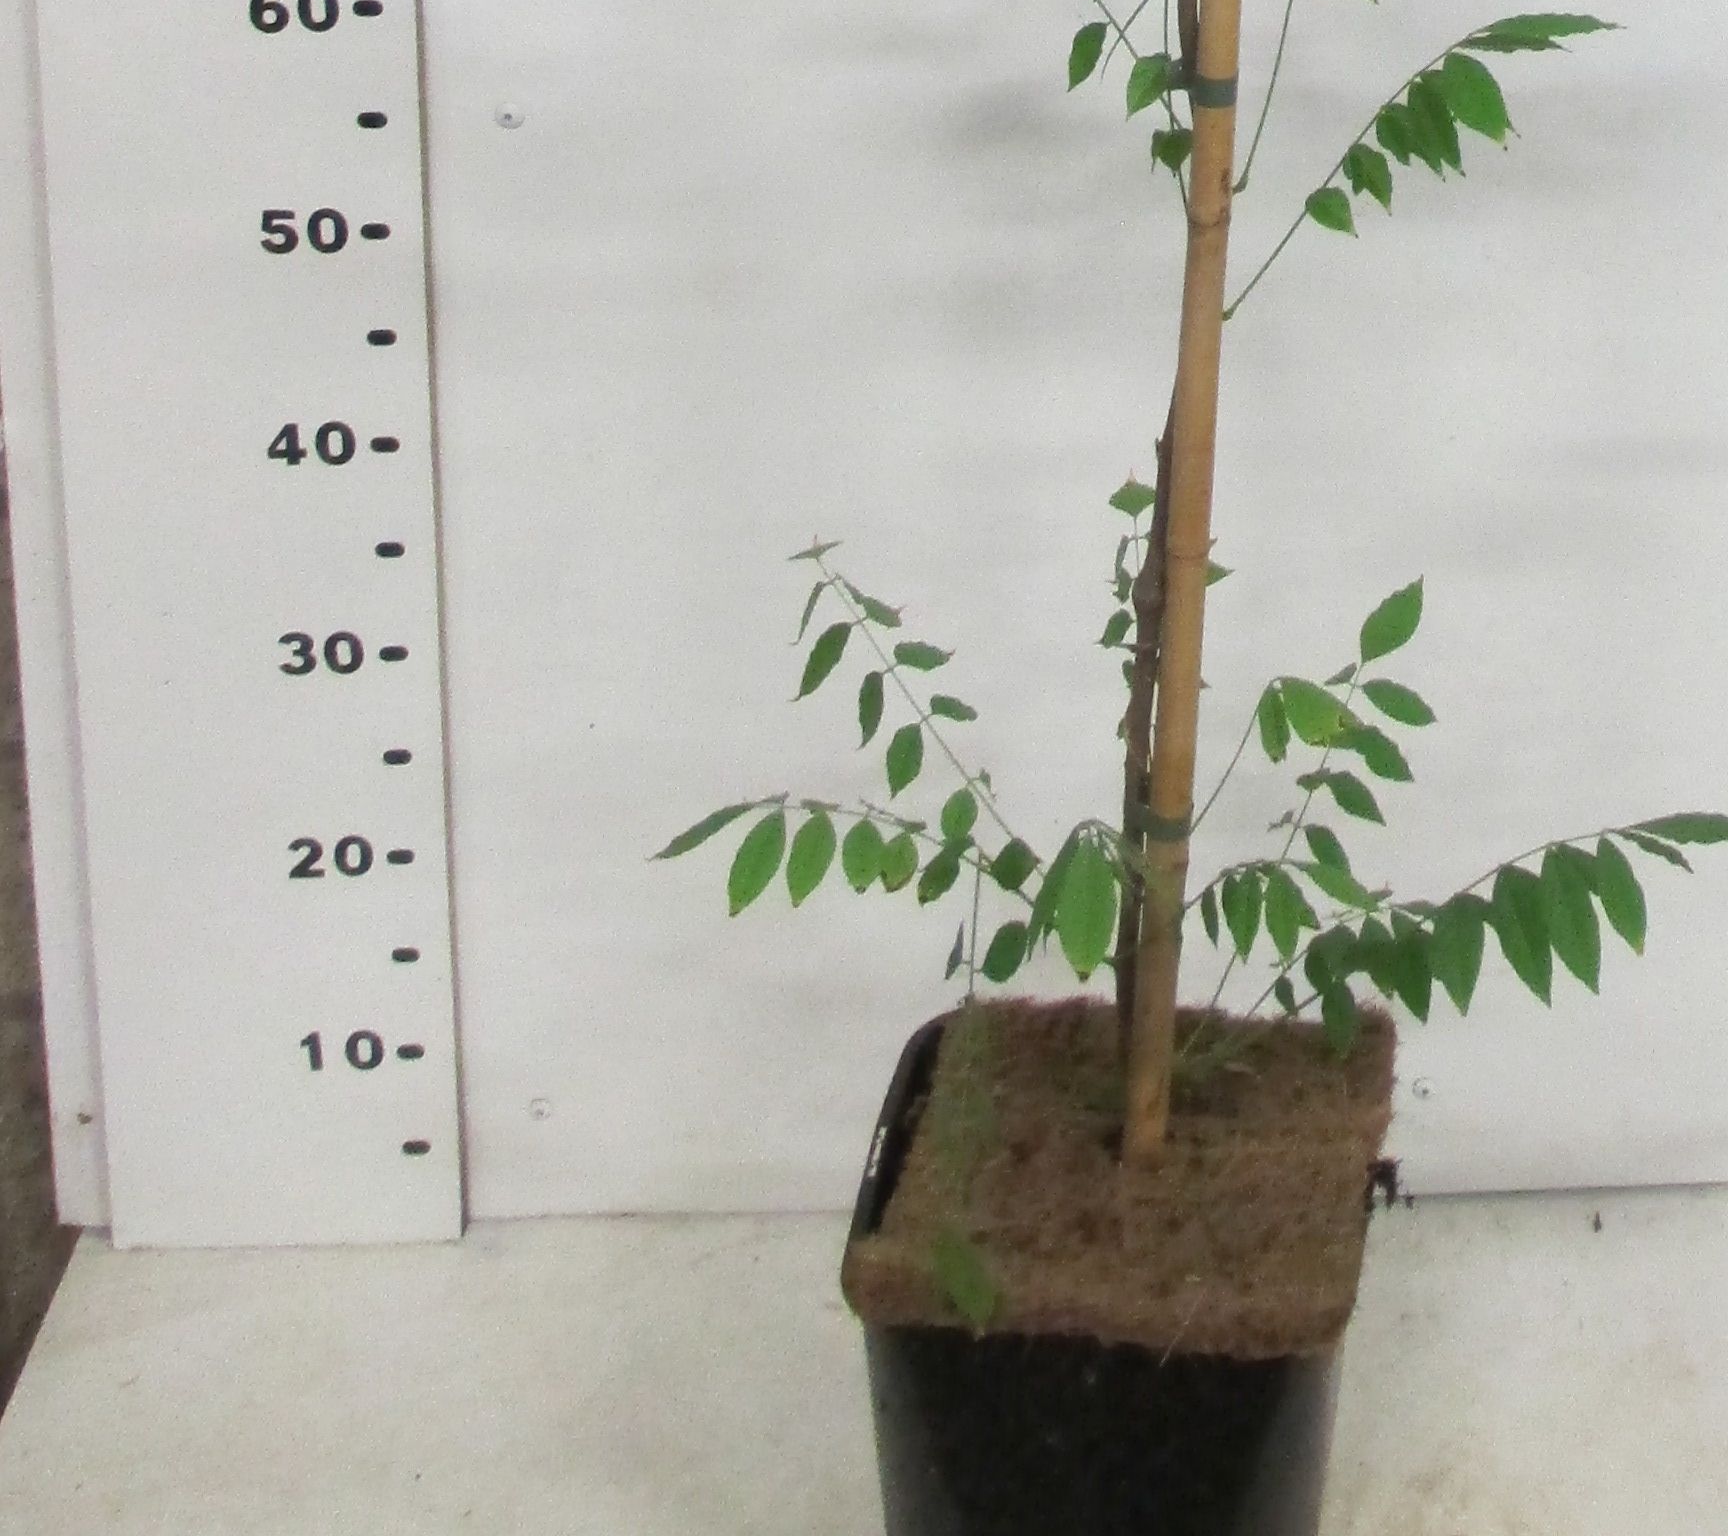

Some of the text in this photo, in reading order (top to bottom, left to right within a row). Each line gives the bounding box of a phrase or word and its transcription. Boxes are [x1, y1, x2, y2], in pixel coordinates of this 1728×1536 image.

[259, 207, 350, 256] 50
[265, 420, 357, 467] 40
[277, 630, 365, 677] 30
[287, 834, 374, 880] 20
[299, 1030, 385, 1072] 10
